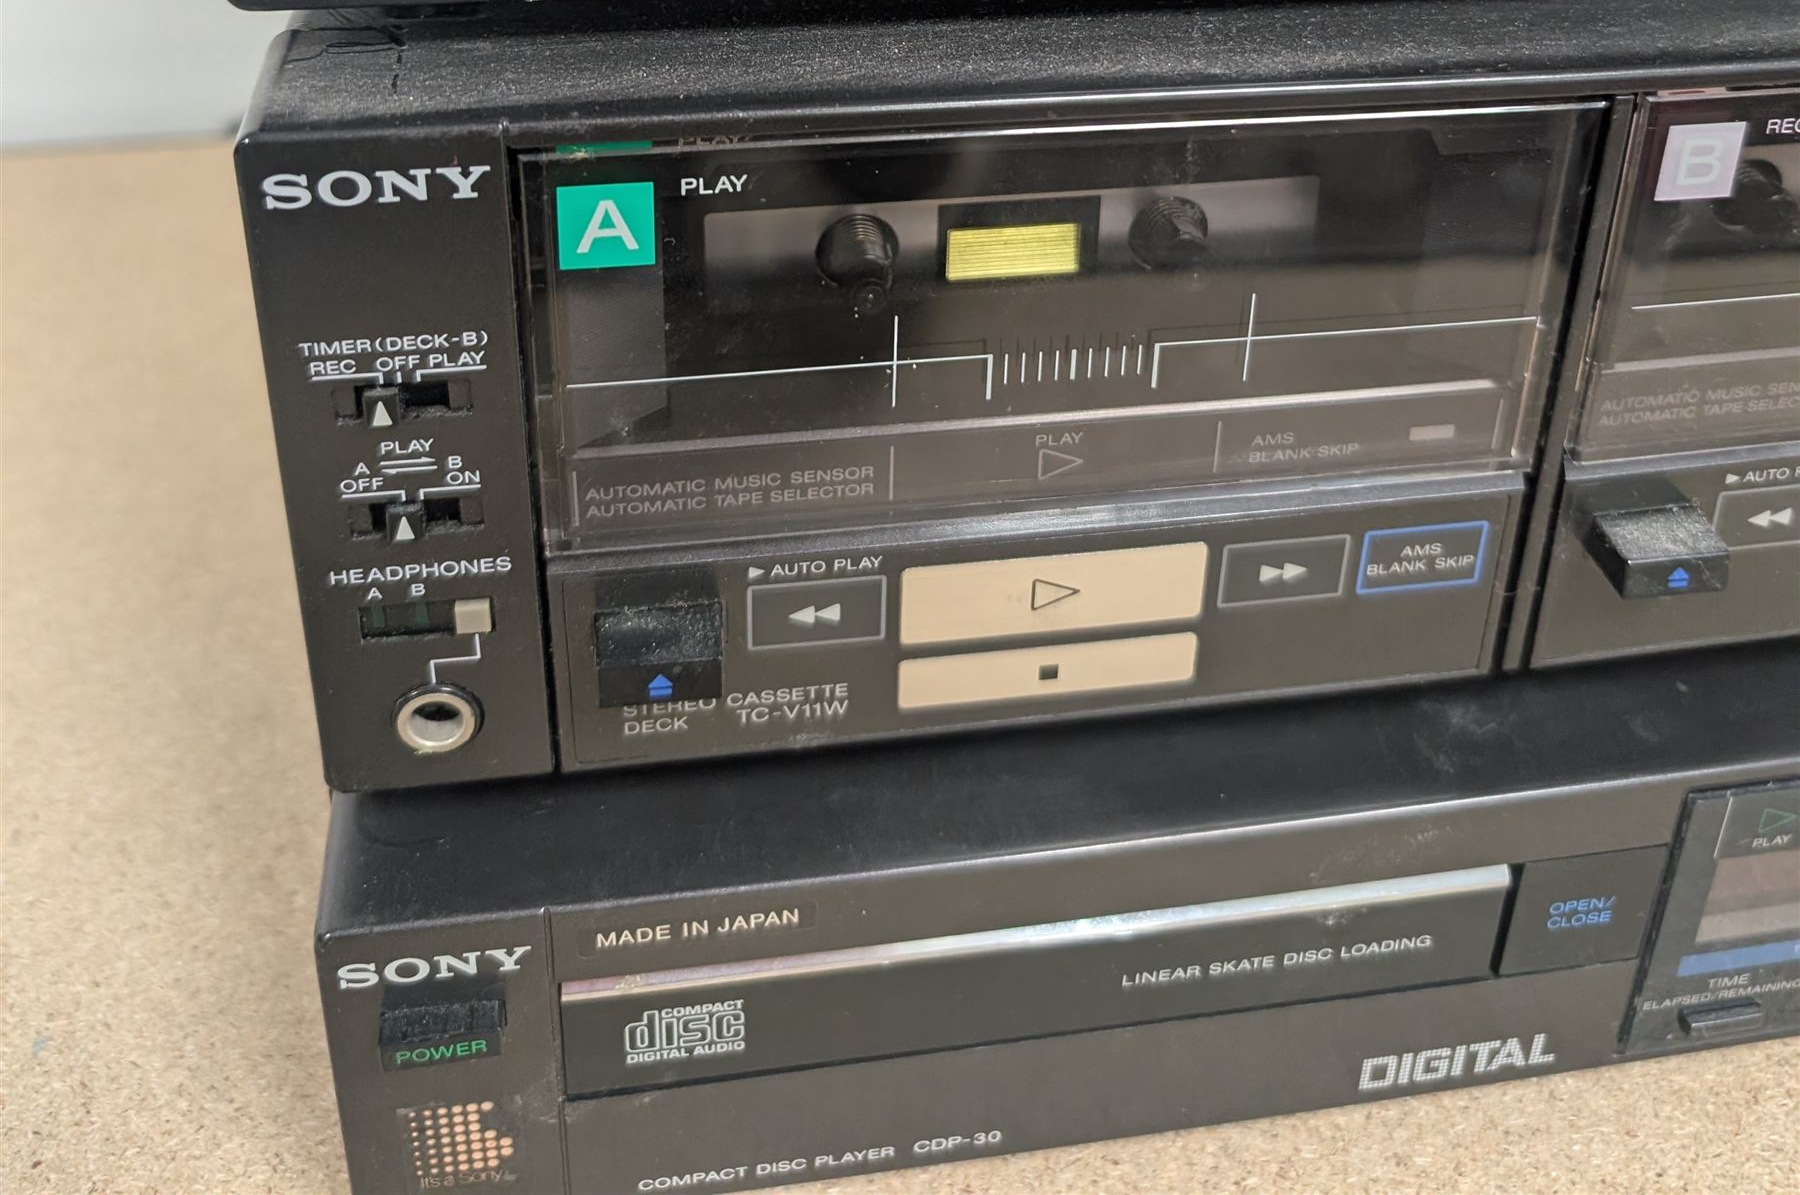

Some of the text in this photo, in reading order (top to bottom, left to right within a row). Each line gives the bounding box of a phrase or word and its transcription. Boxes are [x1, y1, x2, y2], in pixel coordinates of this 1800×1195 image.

[1674, 137, 1724, 186] B
[261, 164, 491, 211] SONY
[680, 173, 748, 197] PLAY
[576, 199, 639, 254] A
[309, 350, 486, 376] REC OFF PLAY
[1600, 390, 1700, 412] AUTOMATIC
[1705, 384, 1761, 402] MUSIC
[1599, 405, 1697, 427] AUTOMATIC
[1703, 402, 1743, 417] TAPE
[380, 437, 435, 455] PLAY
[1035, 431, 1084, 447] PLAY
[1251, 431, 1295, 447] AMS
[448, 455, 463, 469] B
[1249, 442, 1360, 463] BLANK SKIP
[354, 461, 371, 477] A
[446, 469, 482, 486] ON
[1743, 467, 1790, 484] AUTO
[340, 476, 384, 494] OFF
[584, 465, 875, 502] AUTOMATIC MUSIC SENSOR
[585, 482, 875, 519] AUTOMATIC TAPE SELECTOR
[1400, 542, 1443, 558] AMS
[329, 555, 513, 587] HEADPHONES
[769, 555, 884, 577] AUTO PLAY
[1366, 554, 1475, 576] BLANK SKIP
[367, 587, 383, 600] A
[410, 582, 426, 597] B
[726, 682, 849, 707] CASSETTE
[623, 699, 849, 736] DECK TC-V11W
[1751, 833, 1793, 849] PLAY
[1548, 895, 1617, 917] OPEN/
[596, 907, 800, 949] MADE IN JAPAN
[1546, 909, 1612, 931] CLOSE
[337, 944, 532, 990] SONY
[1121, 933, 1433, 988] LINEAR SKATE DISC LOADING
[1707, 972, 1751, 990] TIME
[661, 999, 745, 1018] COMPACT
[624, 1009, 745, 1053] disc
[395, 1039, 488, 1065] POWER
[626, 1040, 746, 1064] DIGITAL AUDIO
[1358, 1032, 1556, 1091] DIGITAL
[637, 1129, 1002, 1192] COMPACT DISC PLAYER CDP-30
[420, 1169, 503, 1188] It's a Sony
